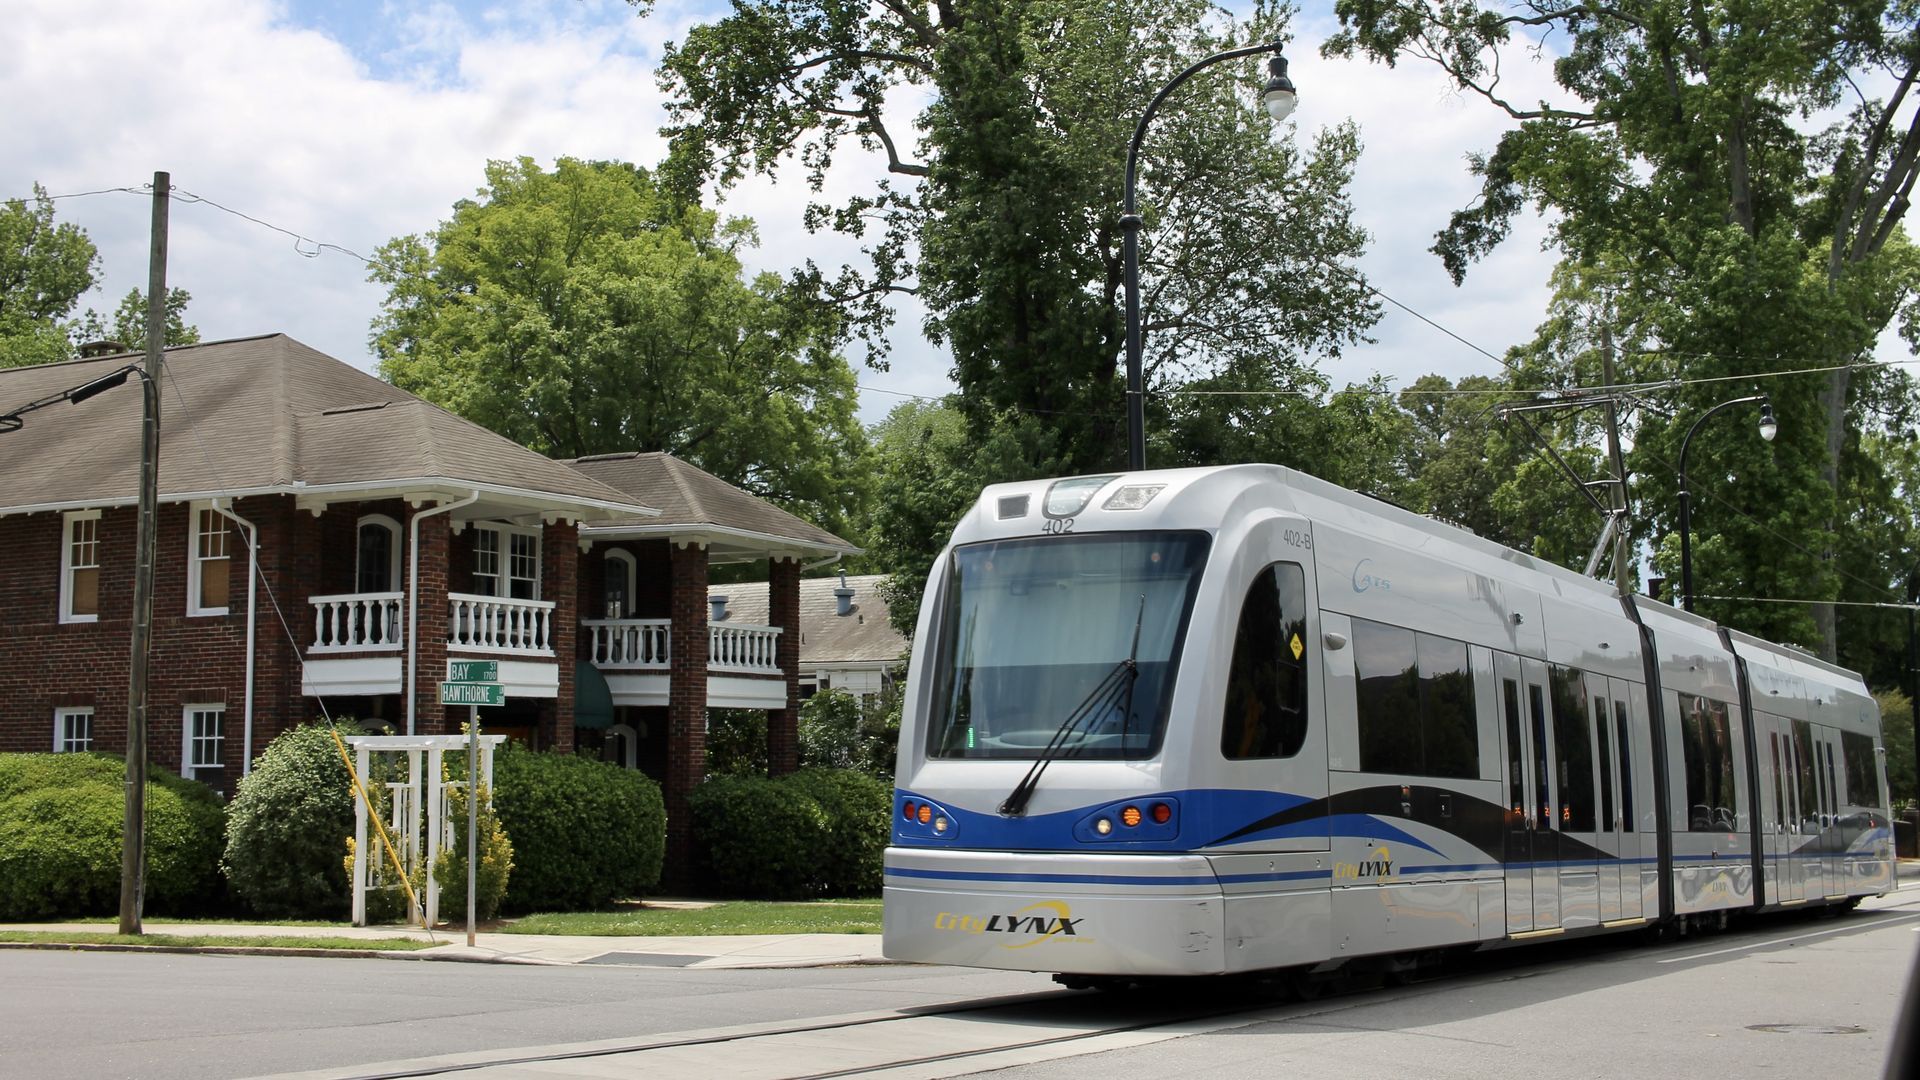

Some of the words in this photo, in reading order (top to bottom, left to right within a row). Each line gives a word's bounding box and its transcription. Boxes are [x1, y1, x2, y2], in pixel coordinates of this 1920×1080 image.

[1041, 518, 1074, 535] 402
[1283, 529, 1312, 550] 402-B
[451, 664, 470, 680] BAY
[483, 671, 497, 680] 1700
[442, 684, 490, 702] HAWTHORNE
[934, 911, 1085, 936] CityLYNX
